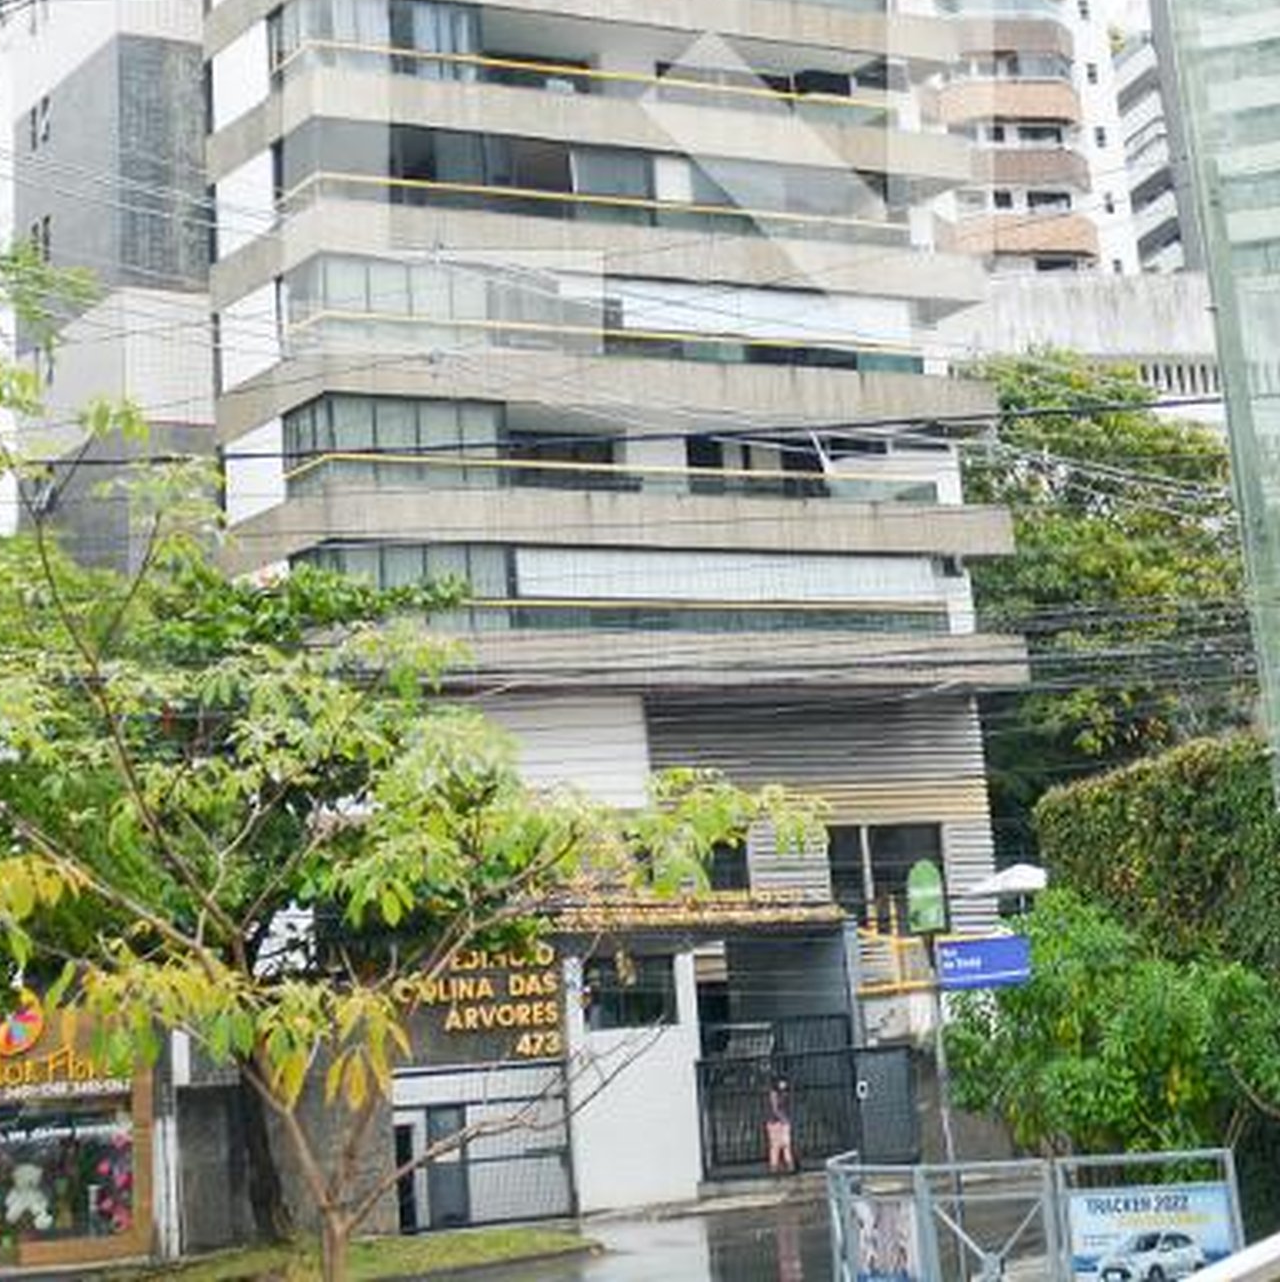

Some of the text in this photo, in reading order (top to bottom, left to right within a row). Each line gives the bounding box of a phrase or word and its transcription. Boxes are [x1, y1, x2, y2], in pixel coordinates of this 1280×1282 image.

[508, 970, 558, 997] DAS
[444, 1001, 559, 1032] ARVORES
[516, 1031, 562, 1056] 473
